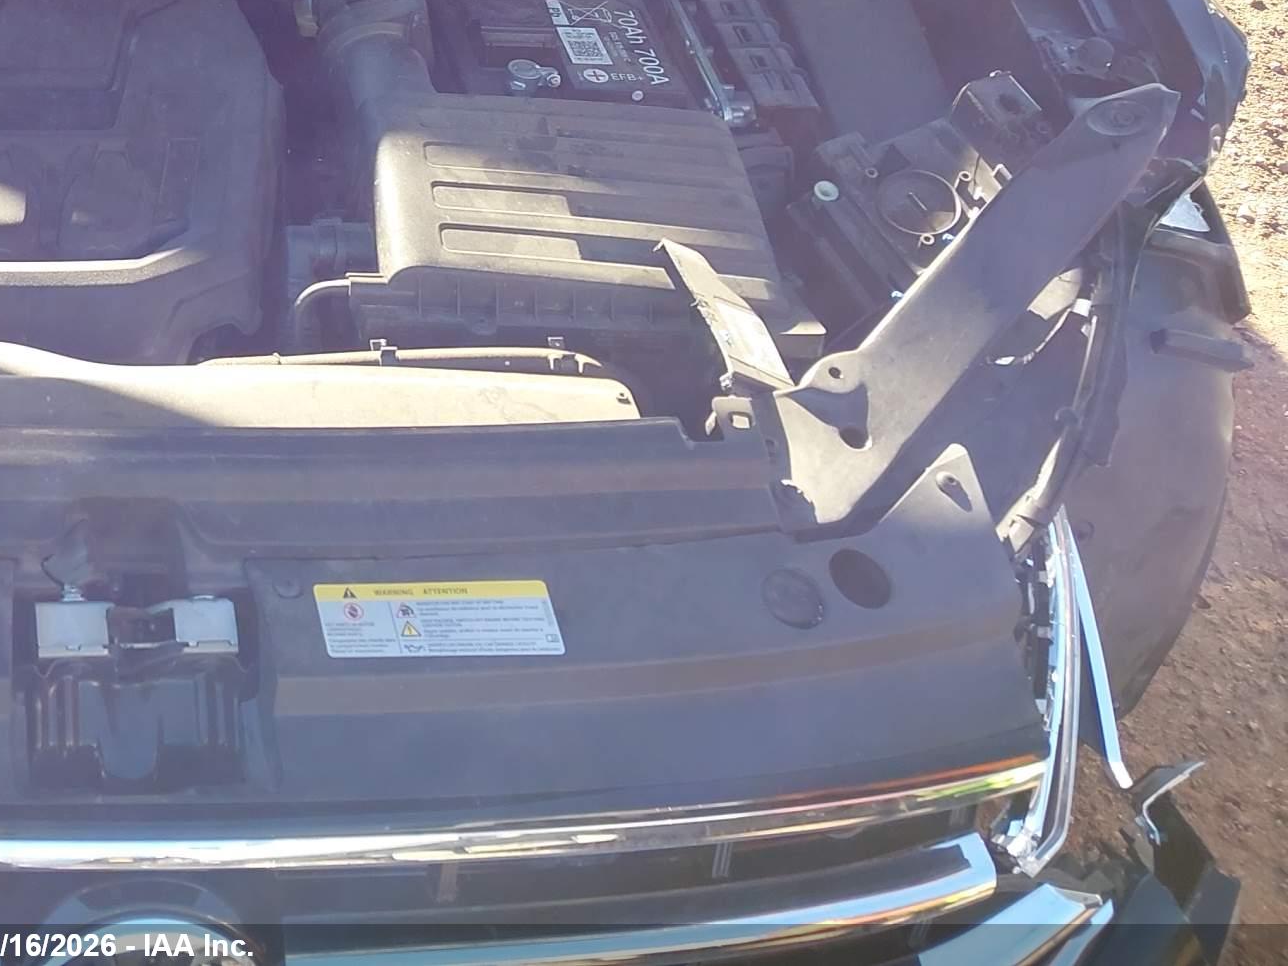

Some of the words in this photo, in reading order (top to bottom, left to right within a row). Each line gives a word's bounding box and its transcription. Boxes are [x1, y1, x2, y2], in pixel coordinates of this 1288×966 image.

[613, 10, 647, 44] 70Ah
[633, 49, 669, 85] 700A
[374, 588, 414, 596] WARNING
[423, 587, 468, 595] ATTENTION
